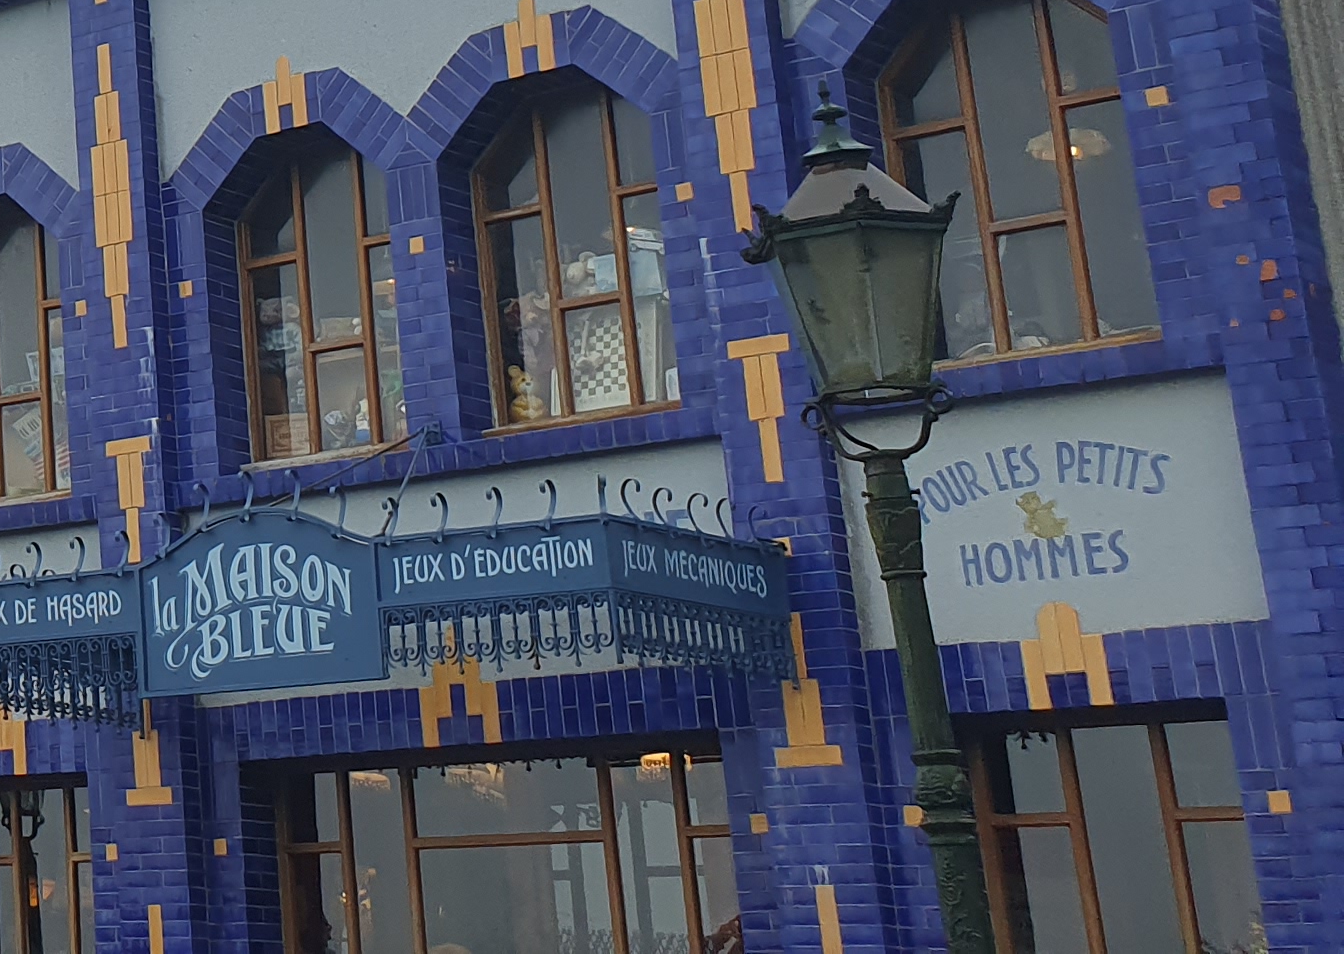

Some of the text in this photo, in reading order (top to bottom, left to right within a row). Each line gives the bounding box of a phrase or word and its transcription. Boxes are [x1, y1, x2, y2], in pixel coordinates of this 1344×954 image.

[985, 444, 1041, 492] LES
[1055, 440, 1172, 494] PETITS
[393, 552, 446, 594] JEUX
[622, 539, 658, 578] JEUX
[958, 529, 1130, 588] HOMMES
[14, 598, 38, 626] DE
[46, 590, 122, 627] HASARD
[166, 543, 353, 664] MAISON
[190, 601, 336, 680] BLEUE
